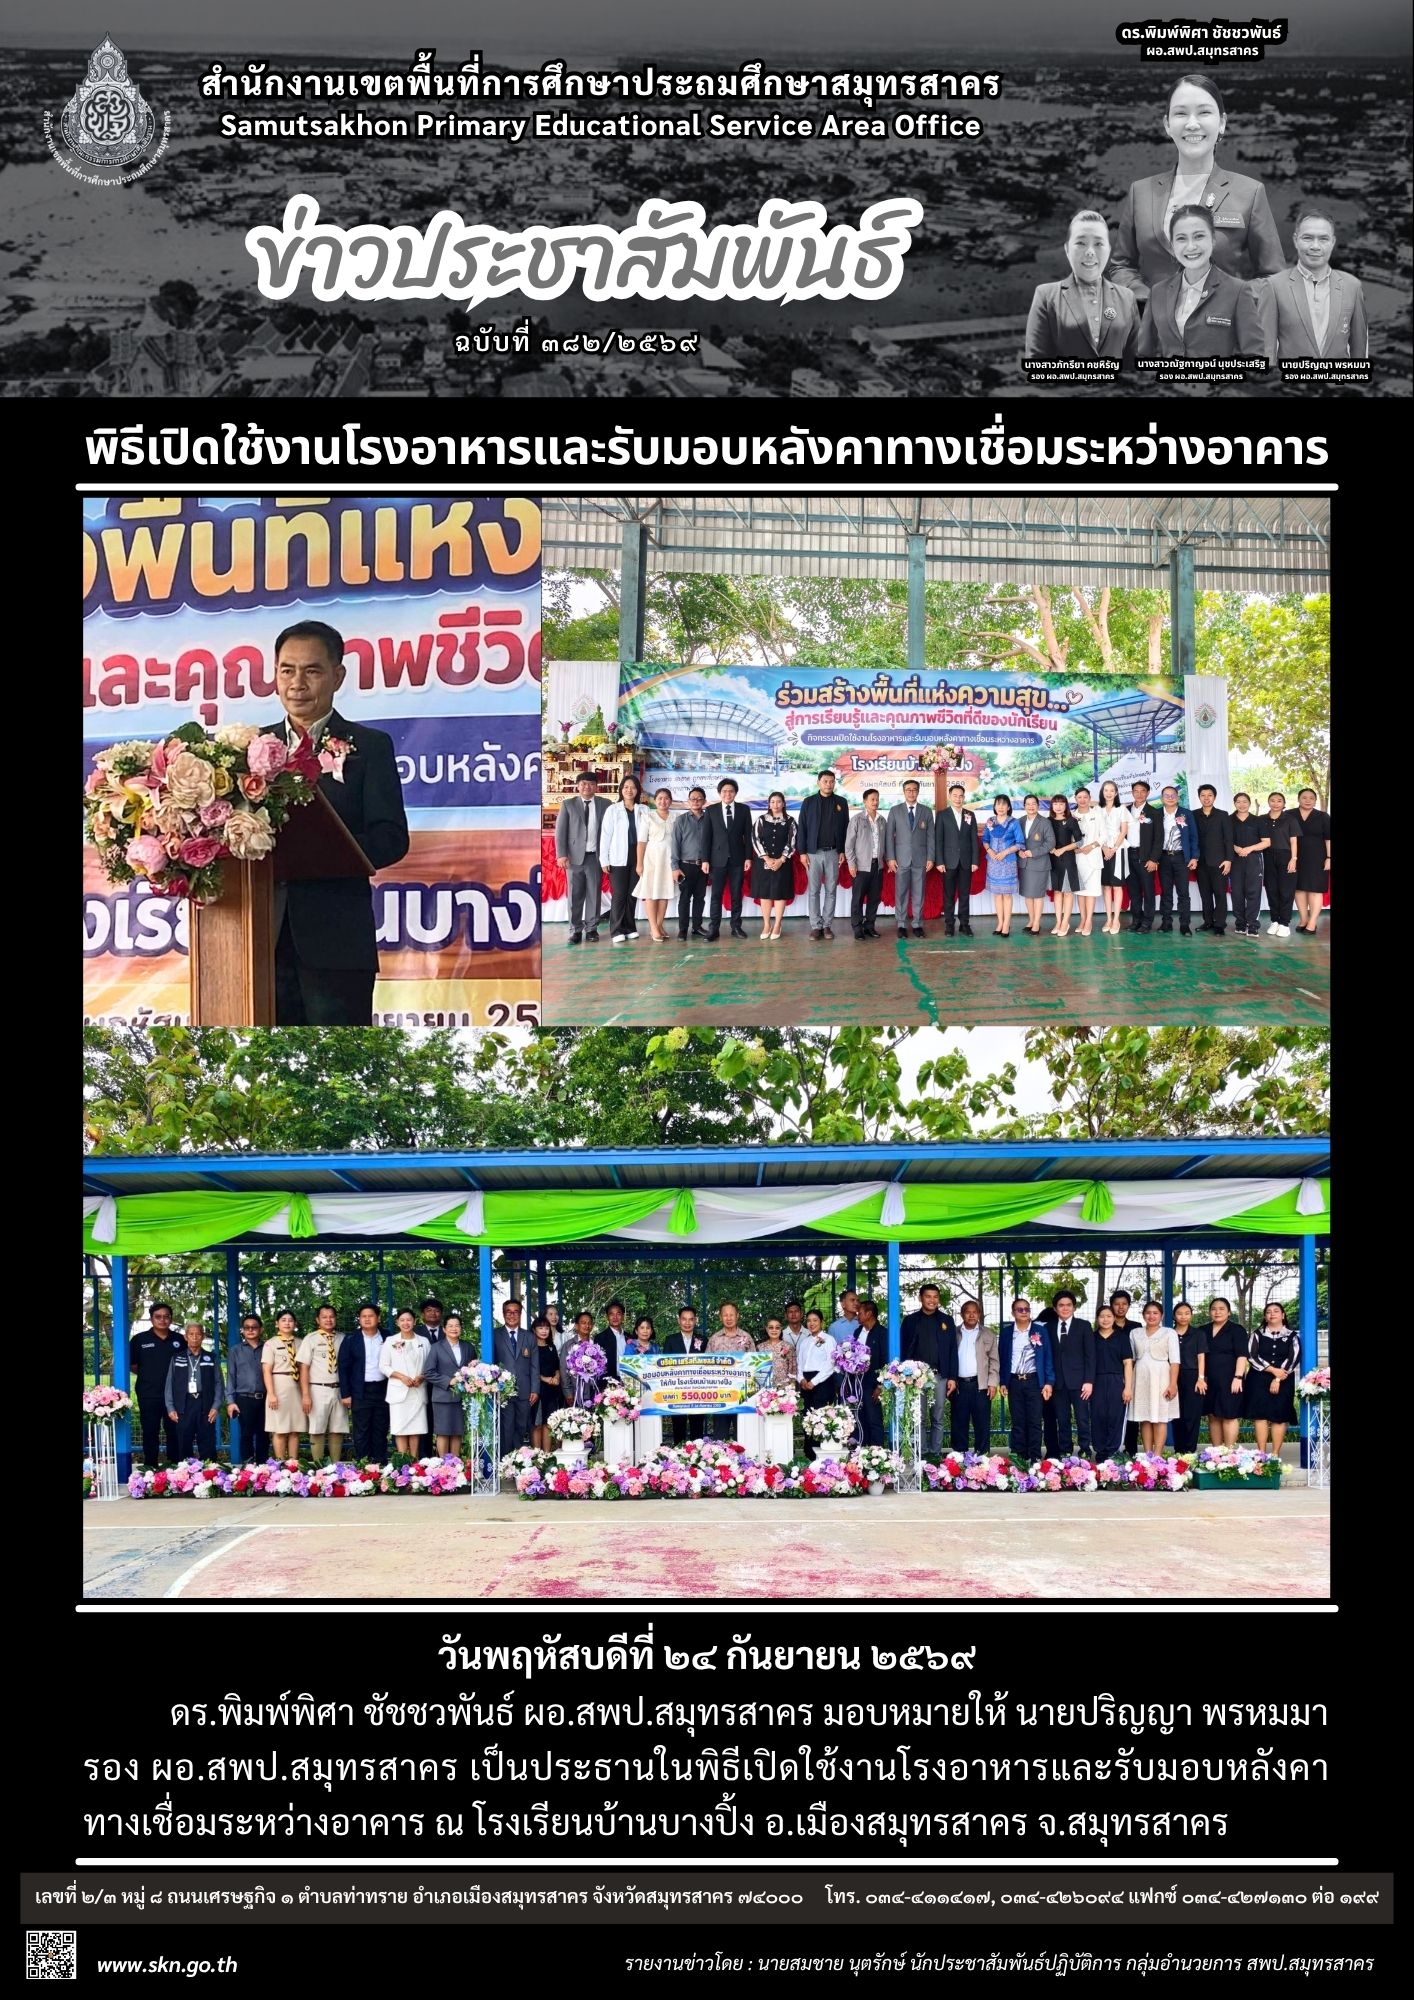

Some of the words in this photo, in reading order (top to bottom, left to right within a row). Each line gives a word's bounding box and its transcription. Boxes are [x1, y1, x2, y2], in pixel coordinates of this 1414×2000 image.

[777, 674, 1068, 716] ร่วมสร้างพื้นที่แห่งความสุข...
[785, 705, 1058, 731] สู่การเรียนรู้และคุณภาพชีวิตที่ดีของนักเรียน
[681, 1391, 719, 1401] 550,000
